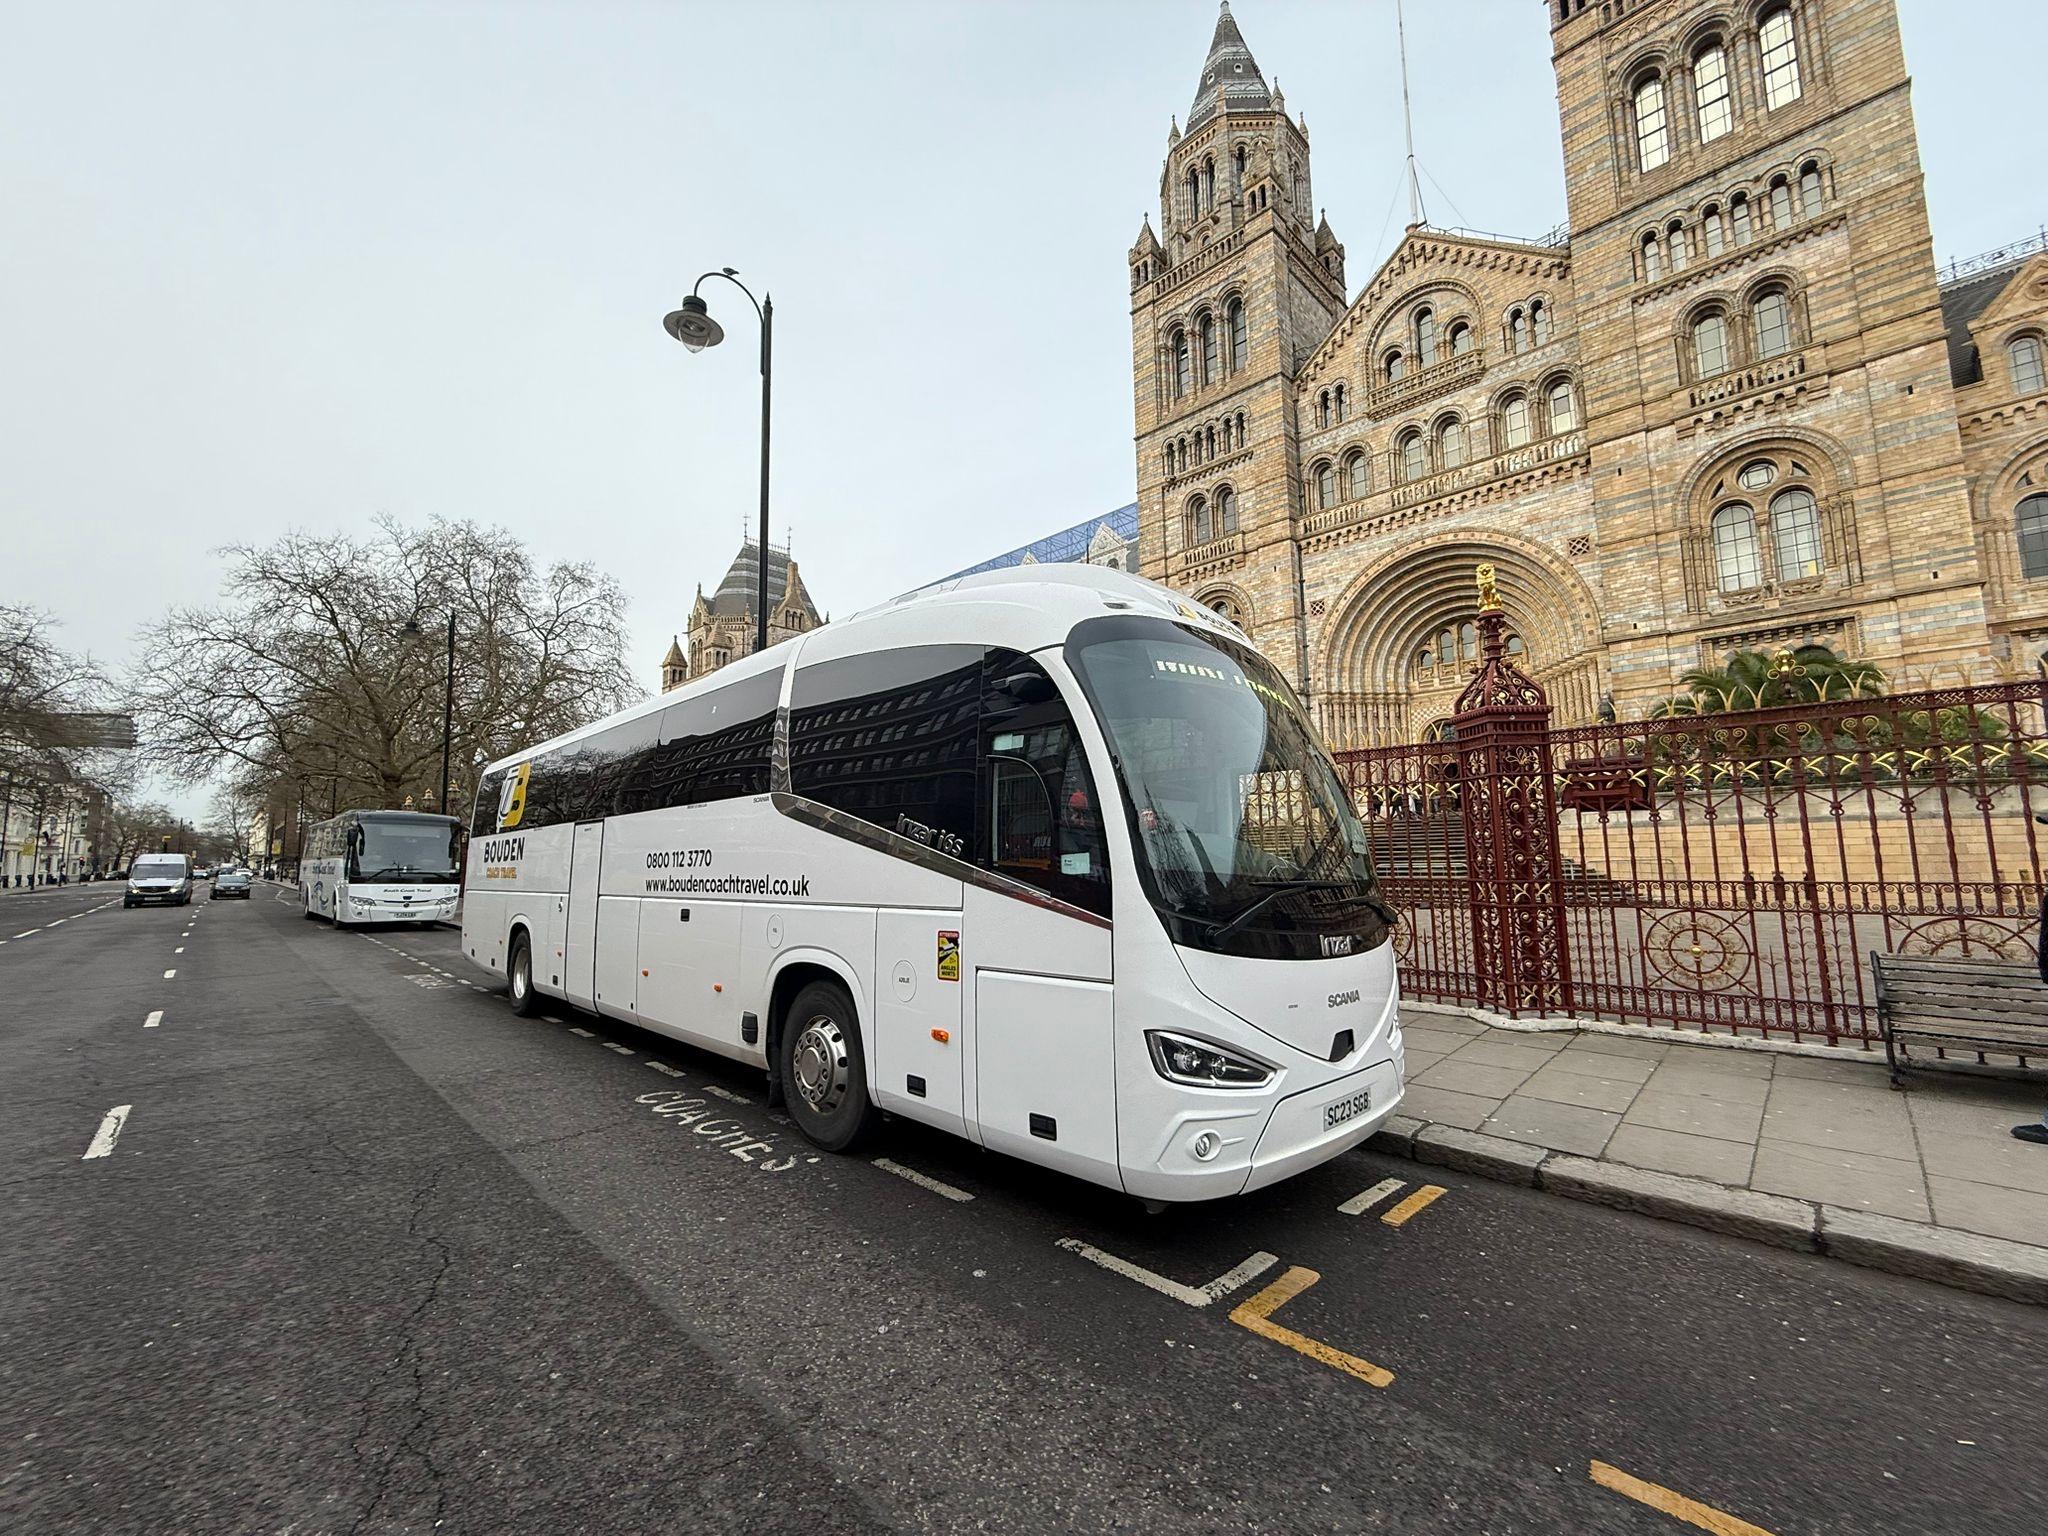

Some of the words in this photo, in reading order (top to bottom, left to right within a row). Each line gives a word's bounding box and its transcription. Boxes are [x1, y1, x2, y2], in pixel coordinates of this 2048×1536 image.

[484, 837, 525, 863] BOUDEN
[937, 829, 964, 857] i6s
[646, 852, 670, 868] 0800
[672, 851, 685, 867] 112
[687, 849, 712, 867] 3770
[645, 874, 810, 896] www.boudencoachtravel.co.uk
[1327, 989, 1361, 1008] SCANIA
[1327, 1099, 1352, 1126] SC23
[1353, 1091, 1369, 1115] SGB
